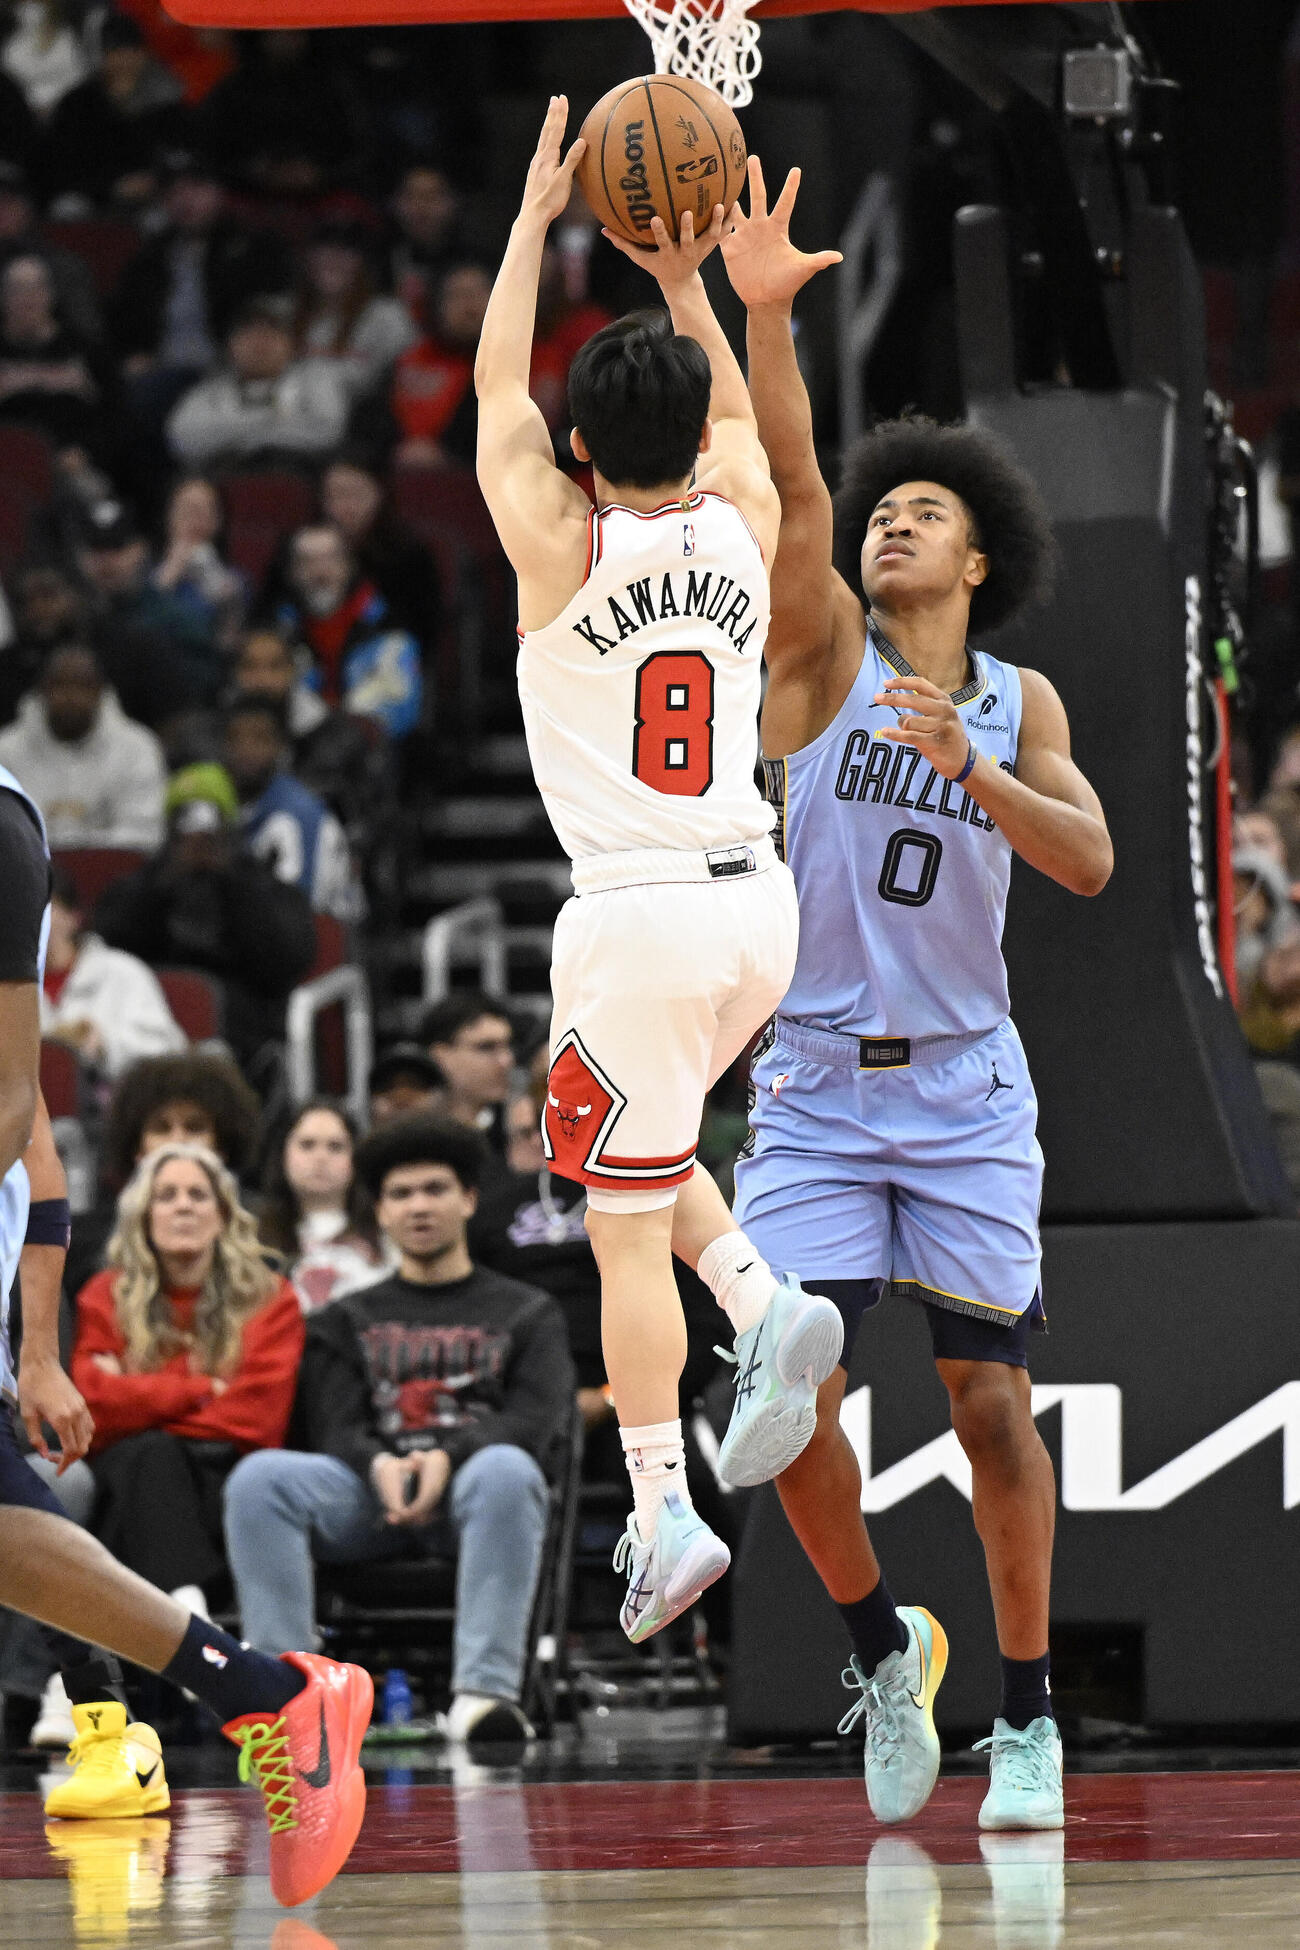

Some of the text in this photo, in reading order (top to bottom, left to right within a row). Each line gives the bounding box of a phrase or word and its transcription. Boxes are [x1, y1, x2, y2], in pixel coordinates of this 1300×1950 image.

[619, 120, 656, 232] Wilson
[573, 570, 758, 655] KAWAMURA
[632, 650, 714, 797] 8
[967, 718, 1009, 734] Robinhood
[877, 827, 943, 907] 0
